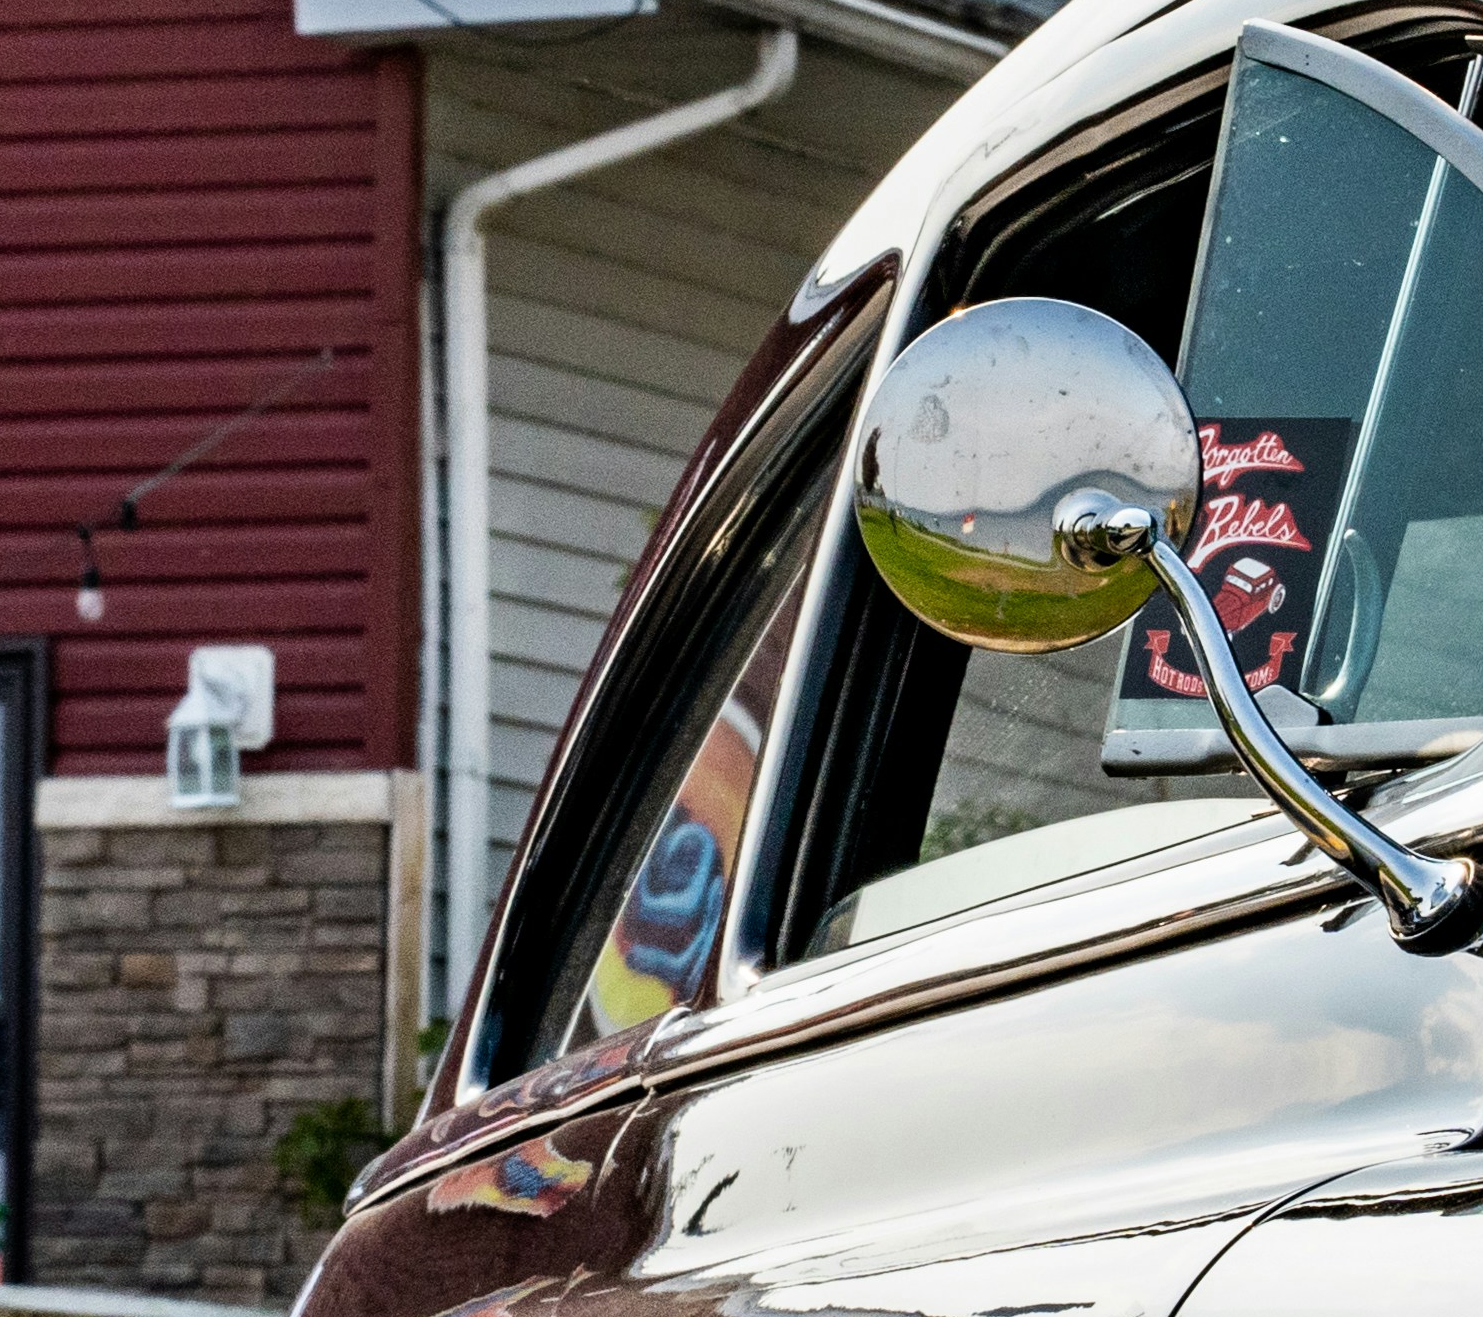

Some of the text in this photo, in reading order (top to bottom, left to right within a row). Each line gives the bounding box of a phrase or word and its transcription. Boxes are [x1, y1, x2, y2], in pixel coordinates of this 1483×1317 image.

[1198, 428, 1296, 485] Forgotten
[1190, 495, 1299, 566] Rebels
[1152, 656, 1175, 687] HOT
